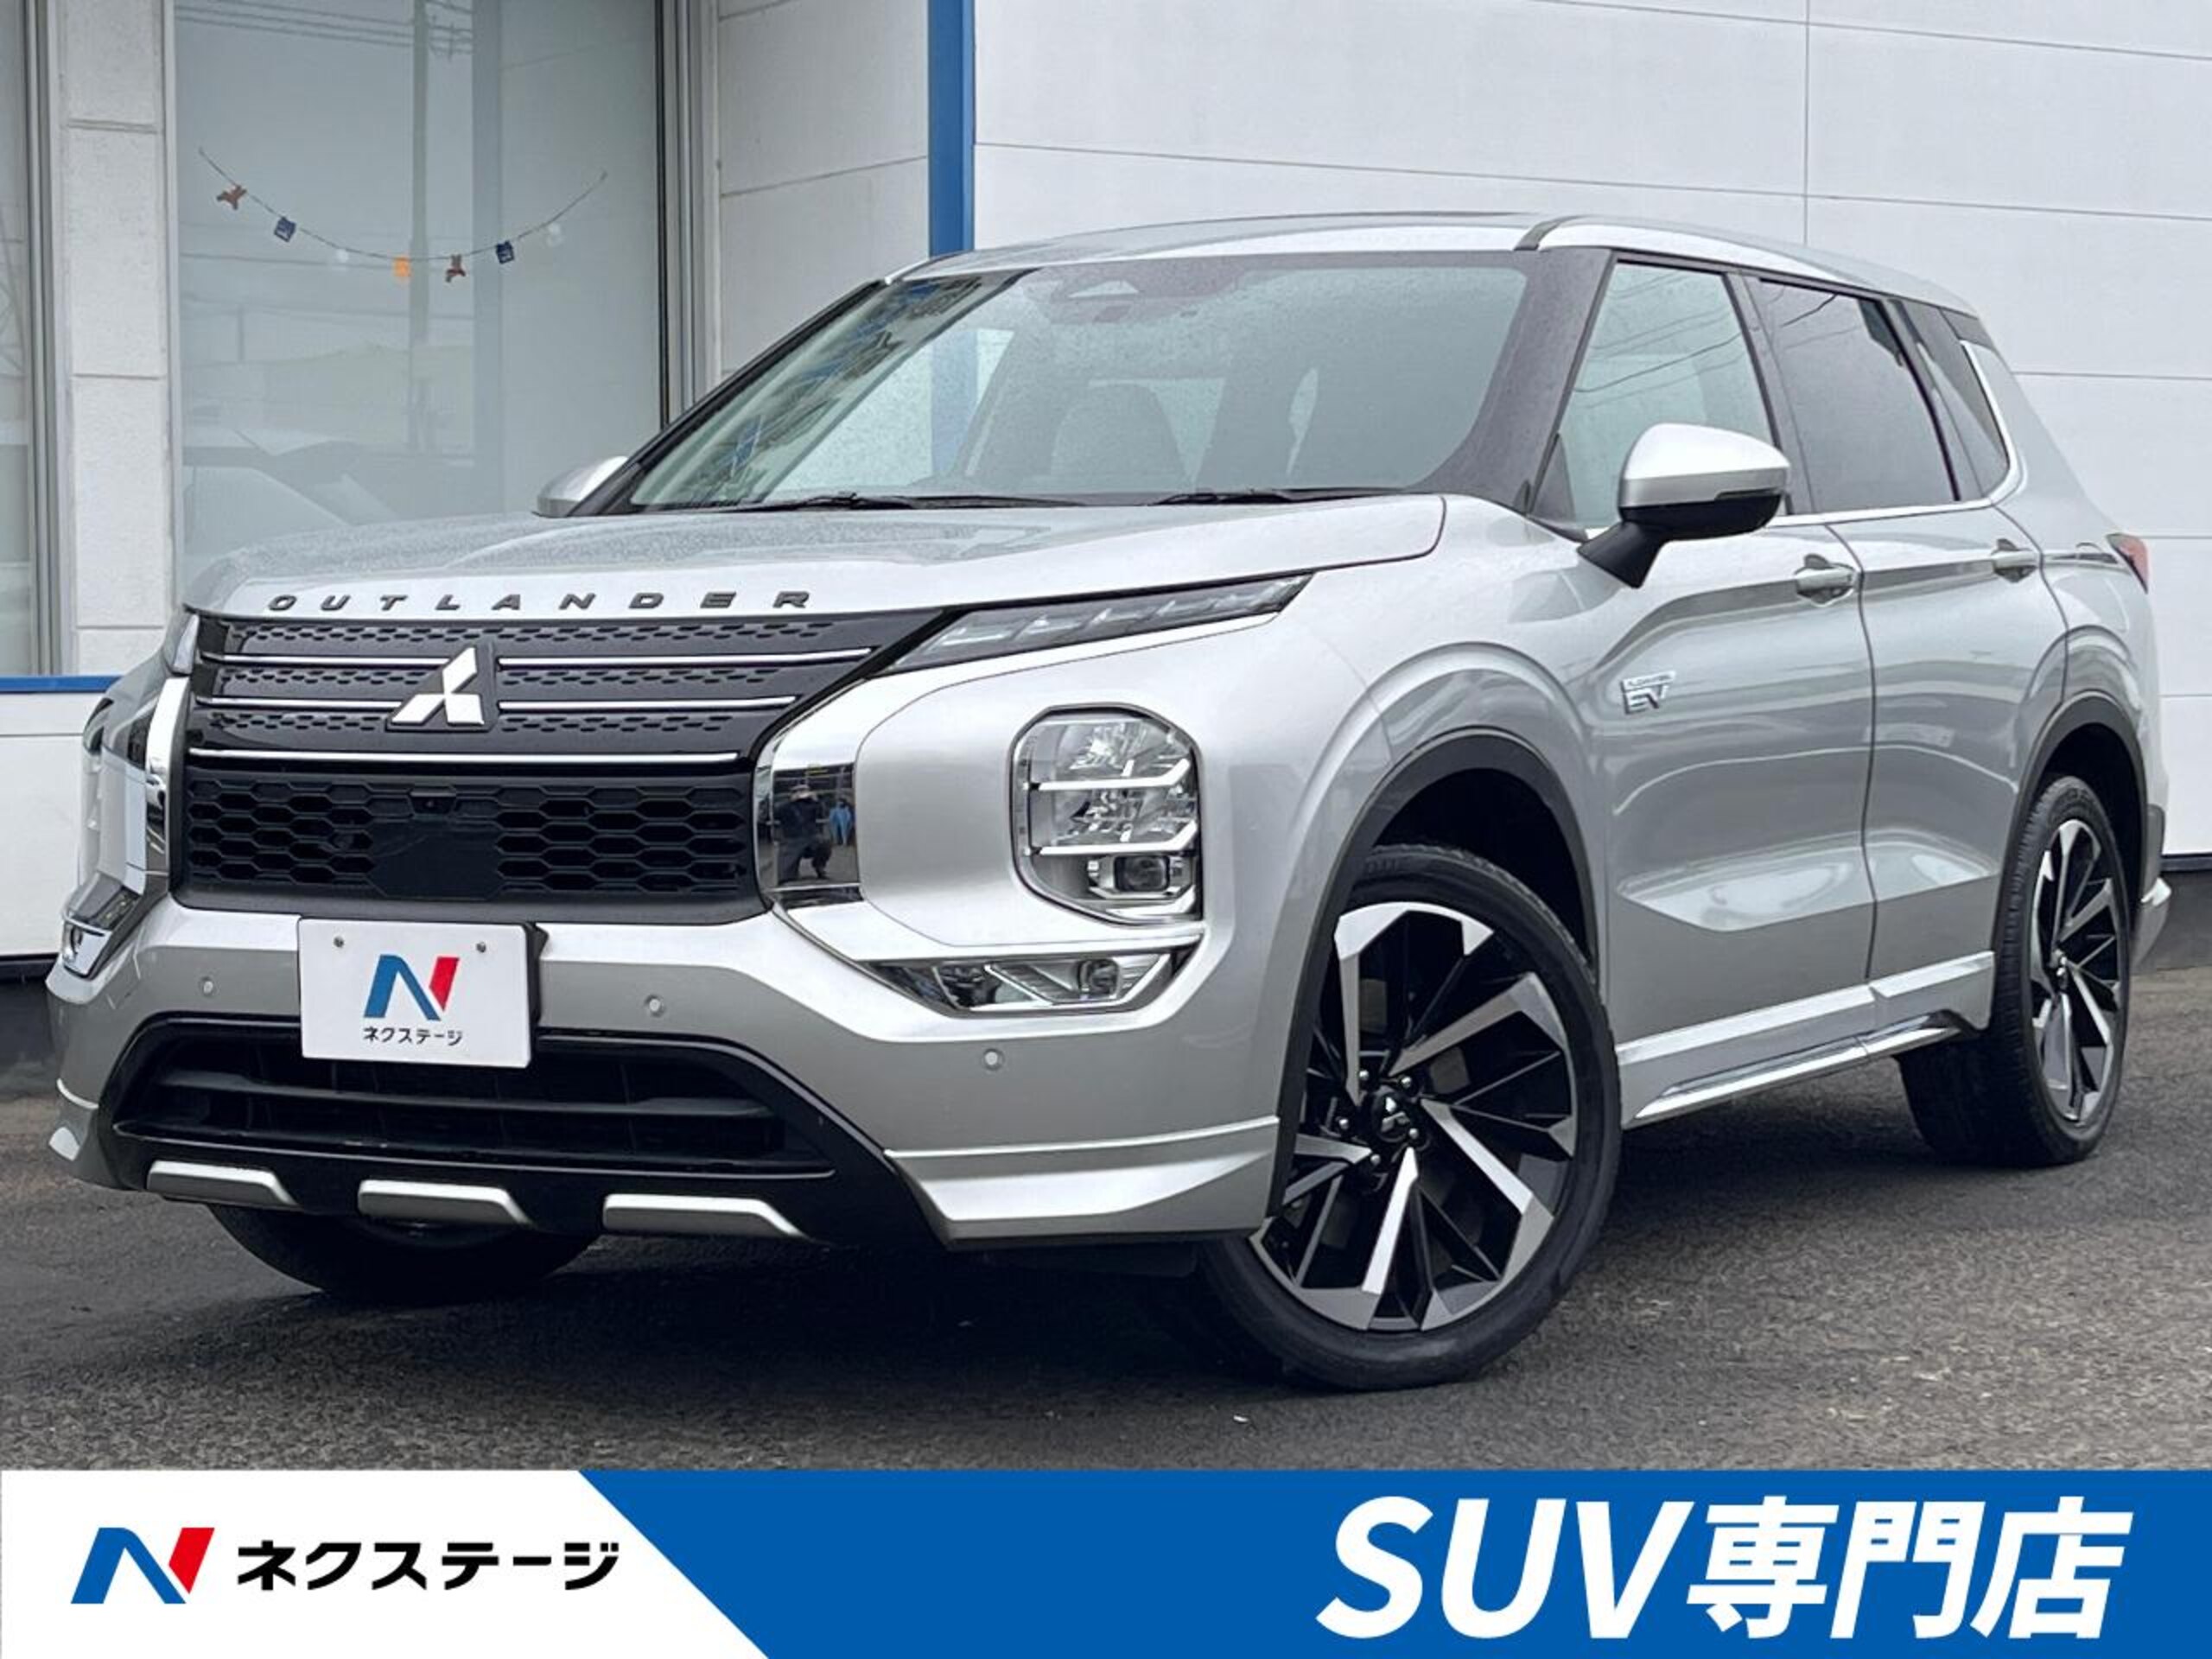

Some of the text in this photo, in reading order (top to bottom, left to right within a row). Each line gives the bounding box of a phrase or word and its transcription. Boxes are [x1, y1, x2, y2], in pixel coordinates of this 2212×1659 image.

[268, 591, 810, 612] OUTLANDER
[363, 1026, 464, 1046] ネクステージ
